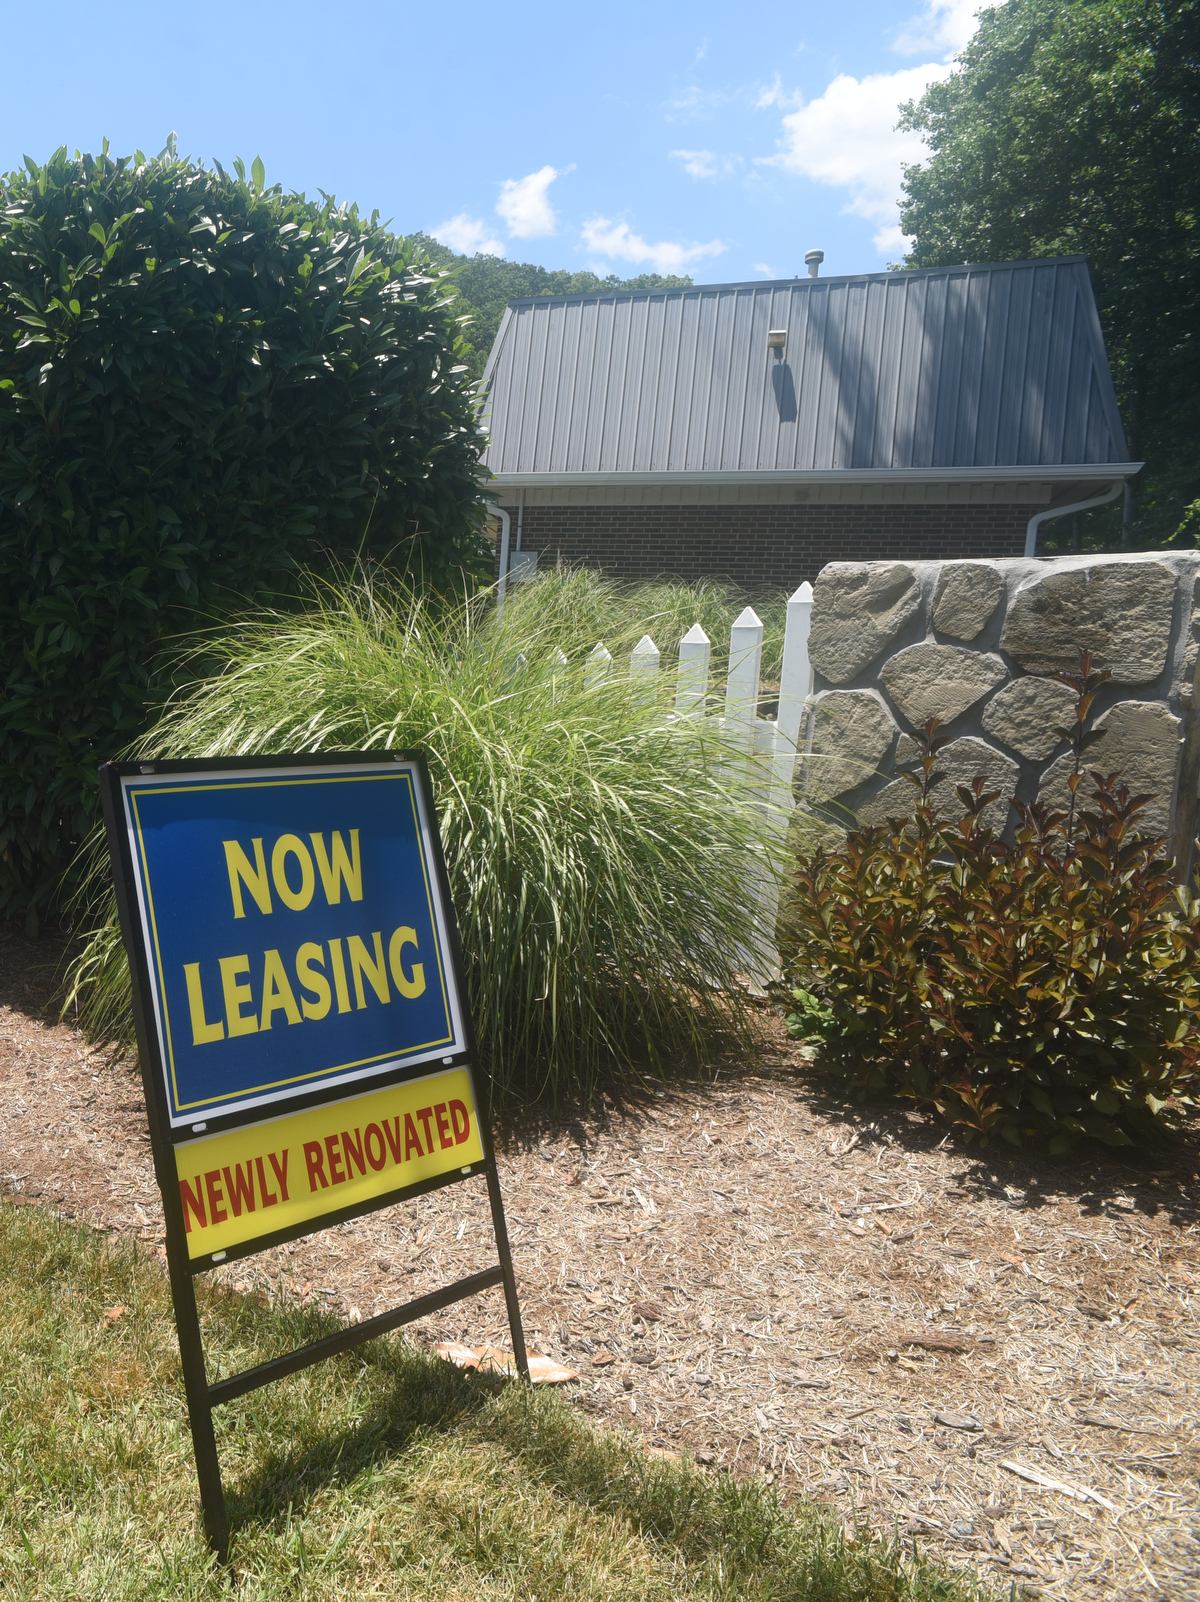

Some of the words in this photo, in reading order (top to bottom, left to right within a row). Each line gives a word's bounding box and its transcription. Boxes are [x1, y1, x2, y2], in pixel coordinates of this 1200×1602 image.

[222, 829, 363, 919] NOW
[183, 926, 427, 1046] LEASING
[179, 1149, 291, 1233] NEWLY
[303, 1099, 471, 1193] RENOVATED
